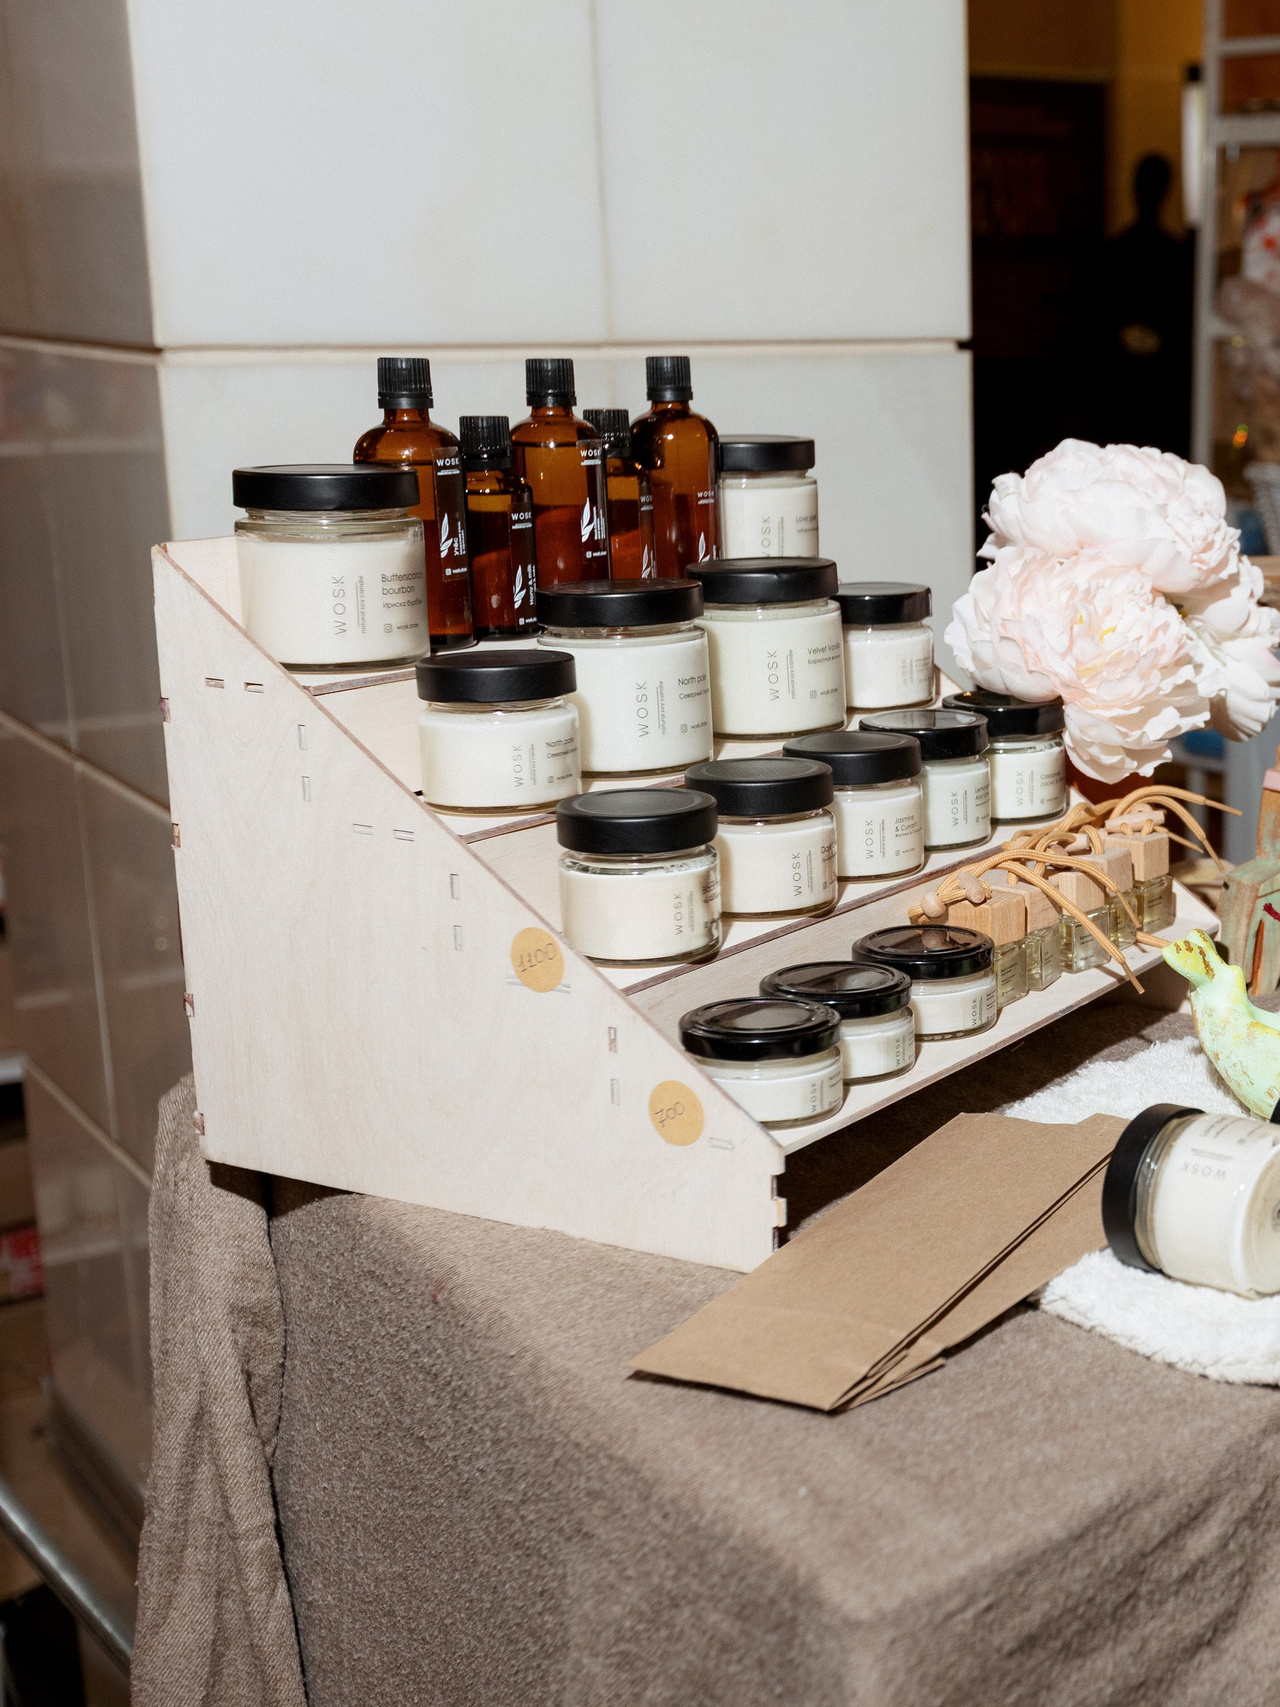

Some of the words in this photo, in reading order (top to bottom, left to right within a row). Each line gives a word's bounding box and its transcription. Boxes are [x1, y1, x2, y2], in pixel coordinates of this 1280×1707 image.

[761, 516, 771, 557] OSK
[332, 575, 347, 636] WOSK
[382, 584, 416, 596] bourbon
[807, 645, 828, 655] Velvet
[678, 676, 697, 686] North
[767, 650, 780, 701] WOSK
[636, 681, 649, 738] WOSK
[512, 744, 523, 787] WOSK
[1016, 770, 1024, 806] WOSK
[895, 815, 915, 824] Jasmine
[951, 790, 959, 827] WOSK
[865, 819, 874, 860] WOSK
[895, 825, 900, 833] &
[792, 852, 802, 897] WOSK
[674, 892, 683, 936] WOSK
[1181, 1161, 1227, 1180] WOSK
